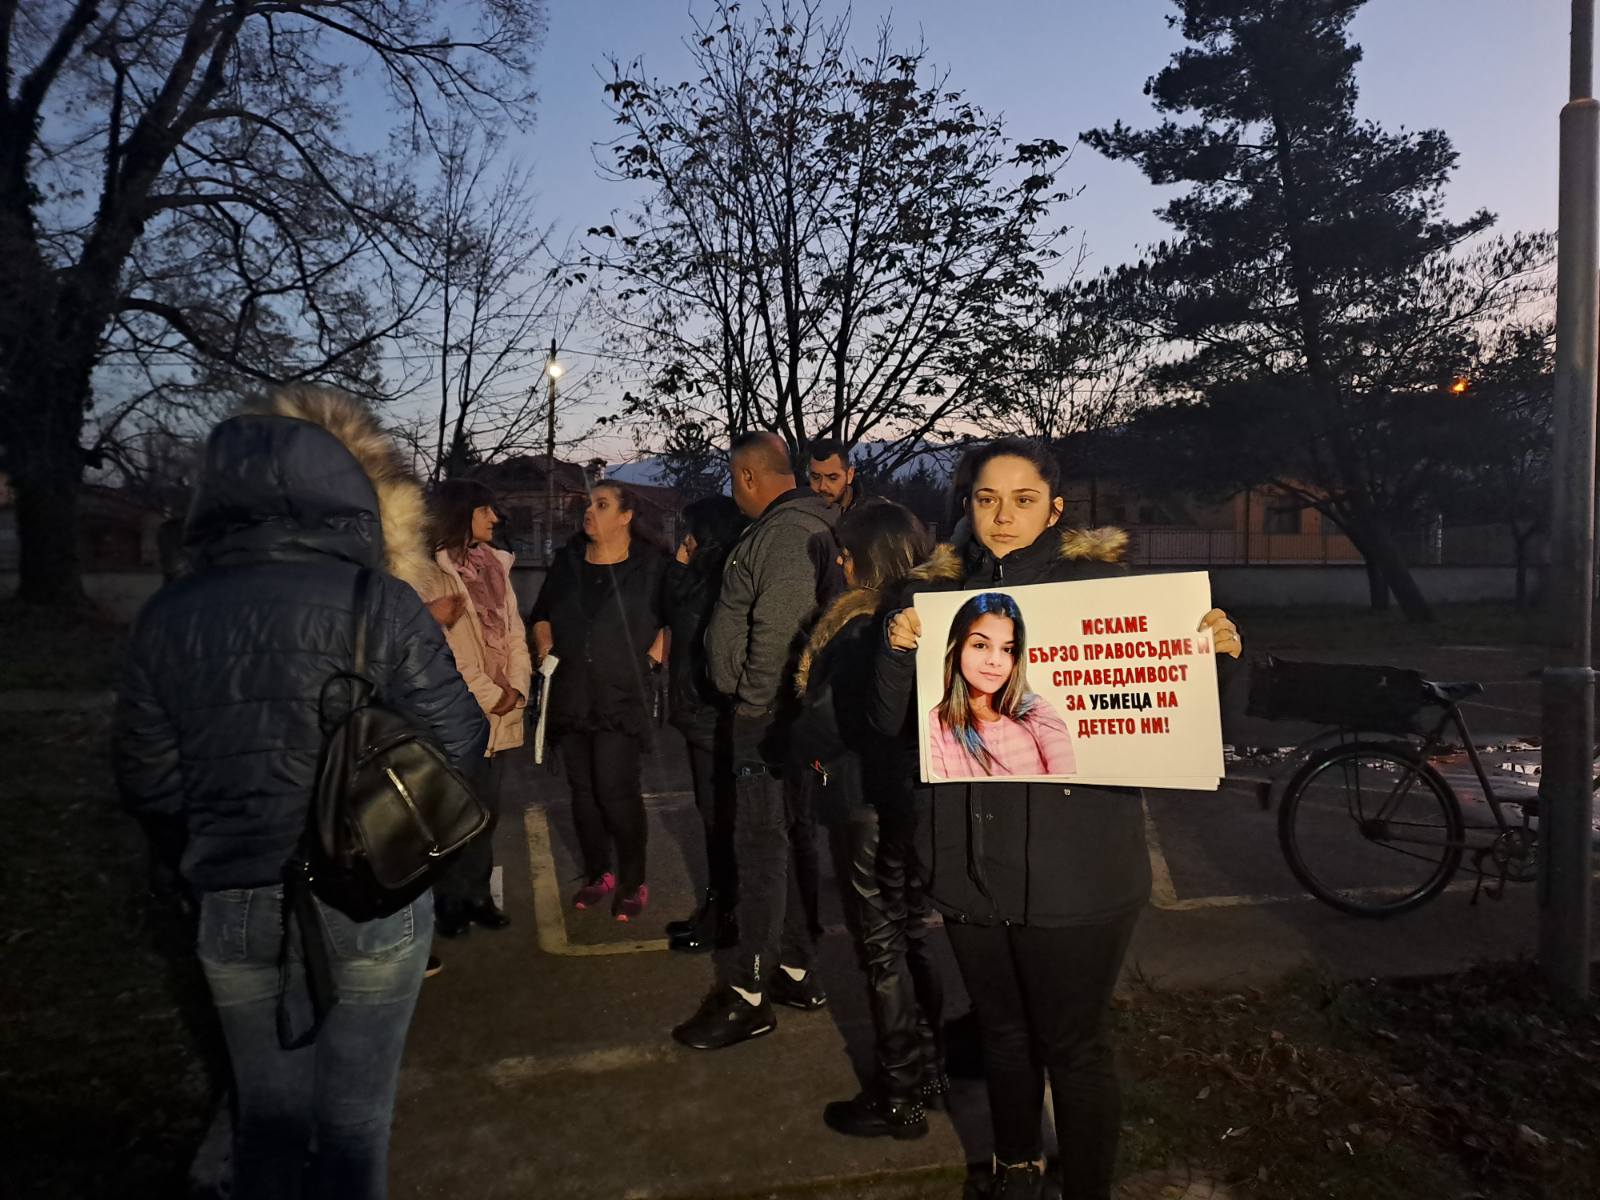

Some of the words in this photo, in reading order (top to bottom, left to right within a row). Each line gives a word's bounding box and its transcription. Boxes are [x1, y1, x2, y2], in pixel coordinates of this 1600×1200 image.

[1082, 616, 1148, 635] ИСКАМЕ
[1029, 645, 1079, 663] БЪРЗО
[1084, 638, 1193, 660] ПРАВОСЪДИЕ
[1198, 637, 1210, 654] И
[1053, 664, 1188, 687] СПРАВЕДЛИВОСТ
[1066, 694, 1086, 711] ЗА
[1089, 692, 1152, 712] УБИЕЦА
[1157, 691, 1178, 708] НА
[1078, 718, 1136, 738] ДЕТЕТО
[1141, 717, 1170, 734] НИ!
